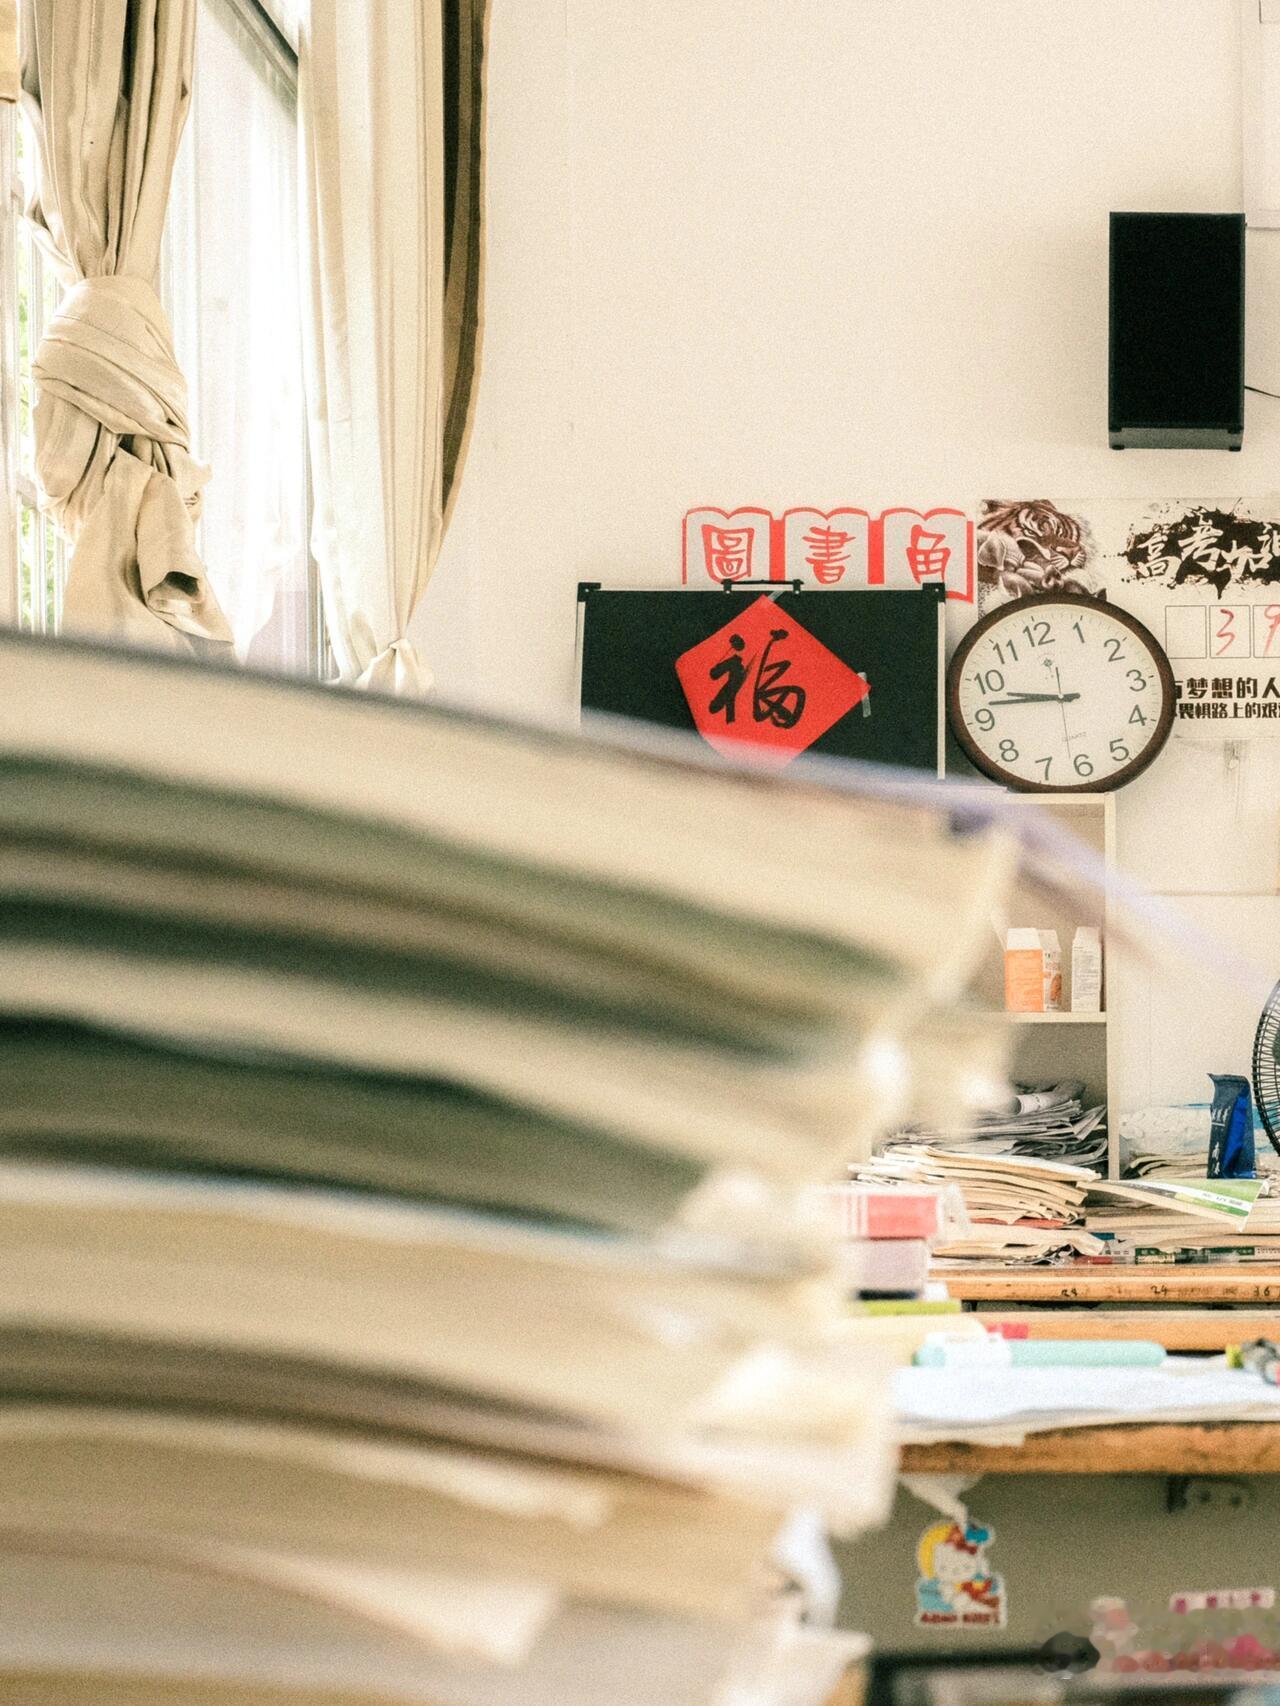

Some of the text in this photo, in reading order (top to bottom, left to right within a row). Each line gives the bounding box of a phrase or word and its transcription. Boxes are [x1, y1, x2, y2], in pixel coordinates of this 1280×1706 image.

[1022, 621, 1056, 649] 12
[1072, 622, 1087, 645] 1
[992, 639, 1019, 666] 11
[1103, 638, 1126, 662] 2
[709, 629, 807, 730] 福
[973, 669, 1006, 695] 10
[1125, 669, 1148, 692] 3
[974, 709, 996, 732] 9
[1127, 705, 1148, 727] 4
[998, 739, 1020, 763] 8
[1108, 738, 1130, 763] 5
[1034, 757, 1055, 782] 7
[1073, 754, 1095, 778] 6
